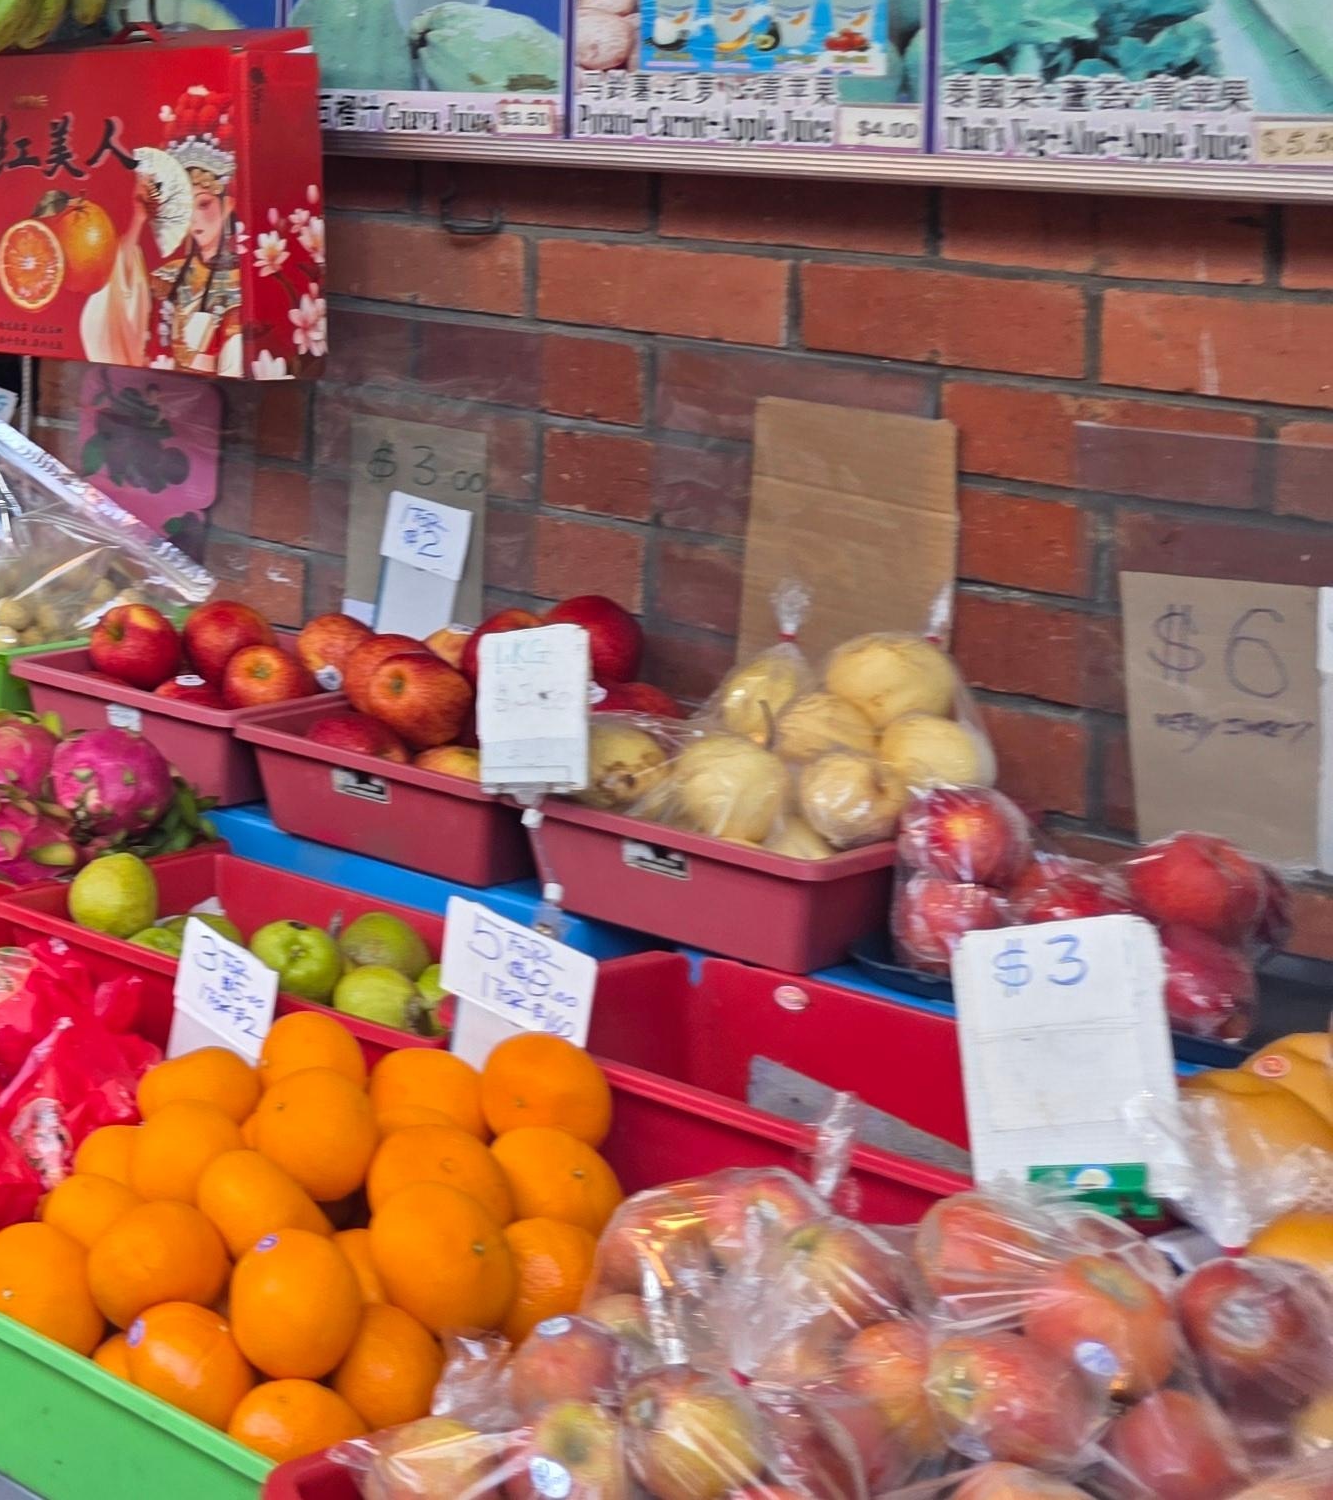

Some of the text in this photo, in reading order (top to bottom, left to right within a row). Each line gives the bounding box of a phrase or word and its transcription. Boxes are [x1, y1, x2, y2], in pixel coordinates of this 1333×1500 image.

[445, 102, 495, 132] Juice
[783, 109, 832, 144] Juice
[855, 118, 920, 140] $4.00
[1192, 123, 1250, 162] Juice
[1148, 603, 1290, 699] $6
[991, 933, 1090, 999] $3
